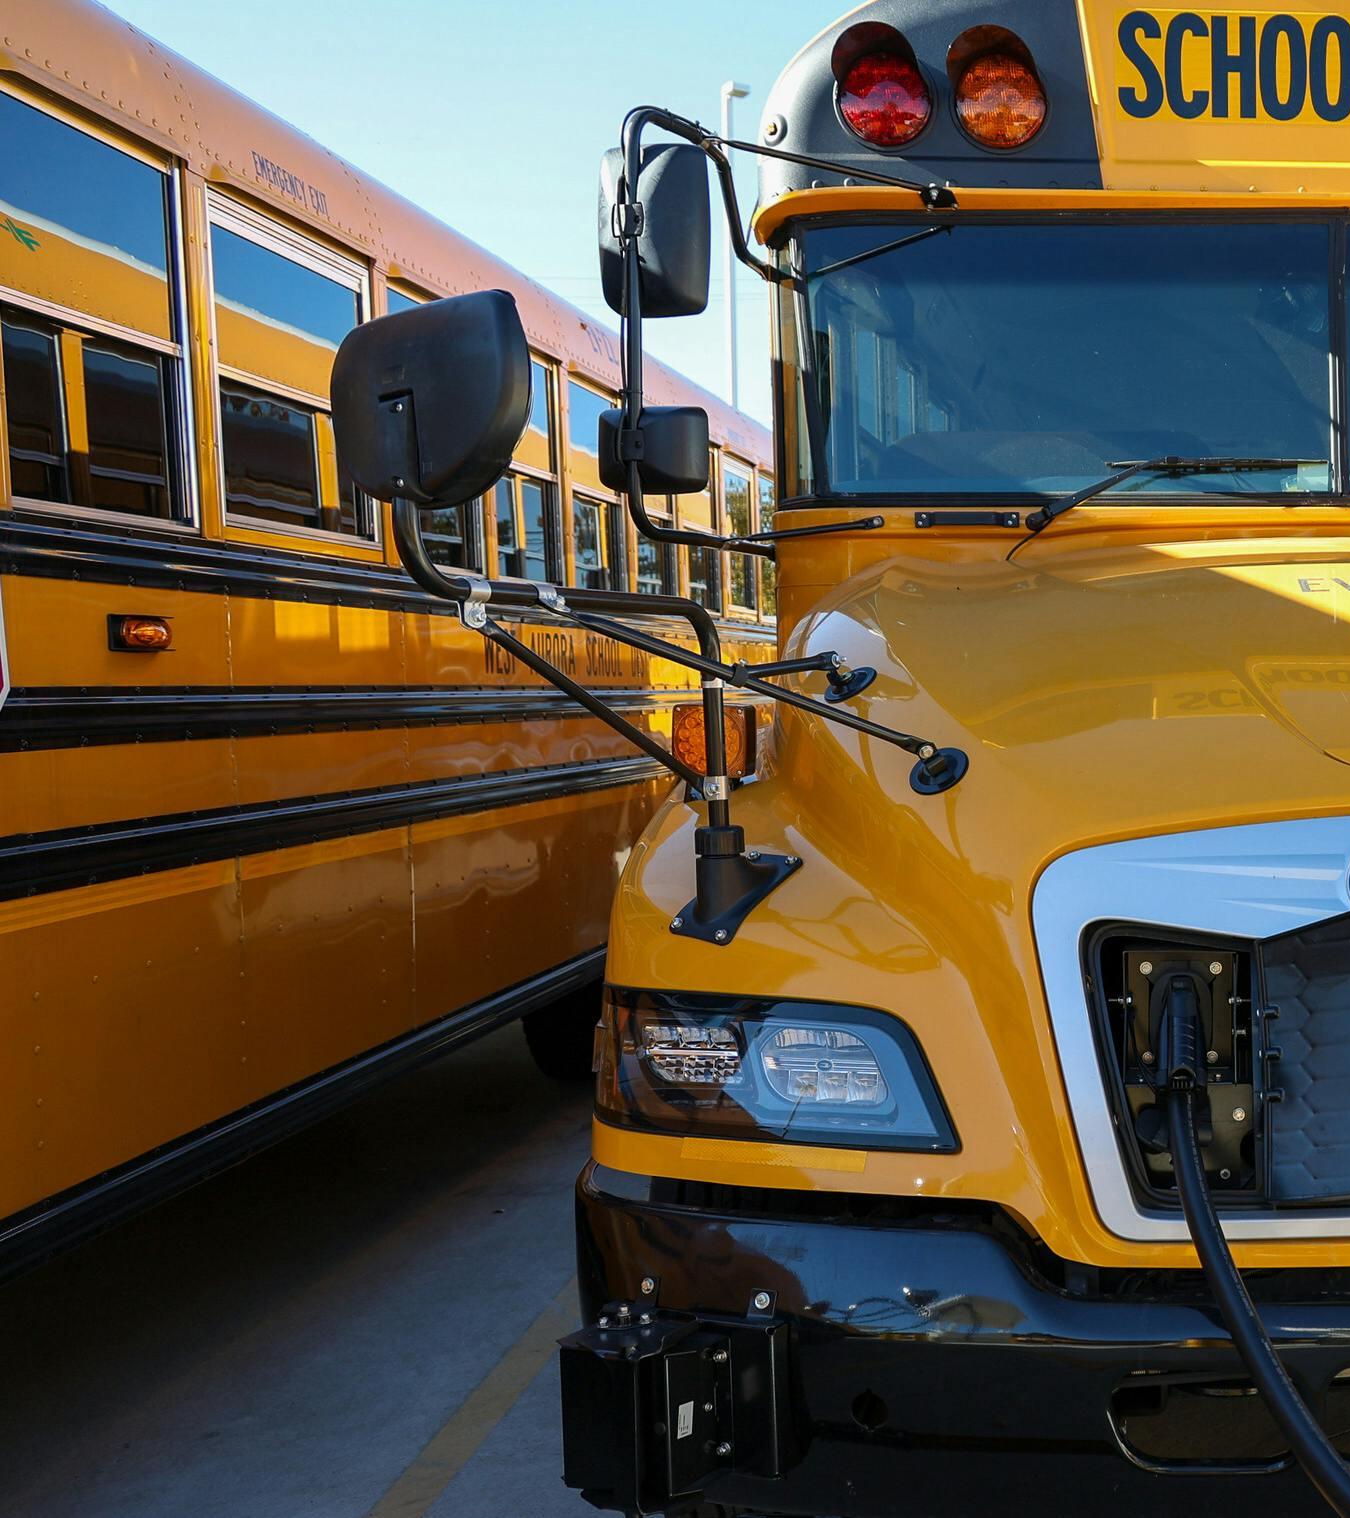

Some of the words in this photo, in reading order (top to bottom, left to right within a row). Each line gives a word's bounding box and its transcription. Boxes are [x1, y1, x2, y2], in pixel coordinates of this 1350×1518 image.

[251, 150, 308, 209] EMERGENCY
[308, 185, 329, 217] EXIT
[529, 631, 576, 675] AURORA
[586, 635, 622, 678] SCHOOL
